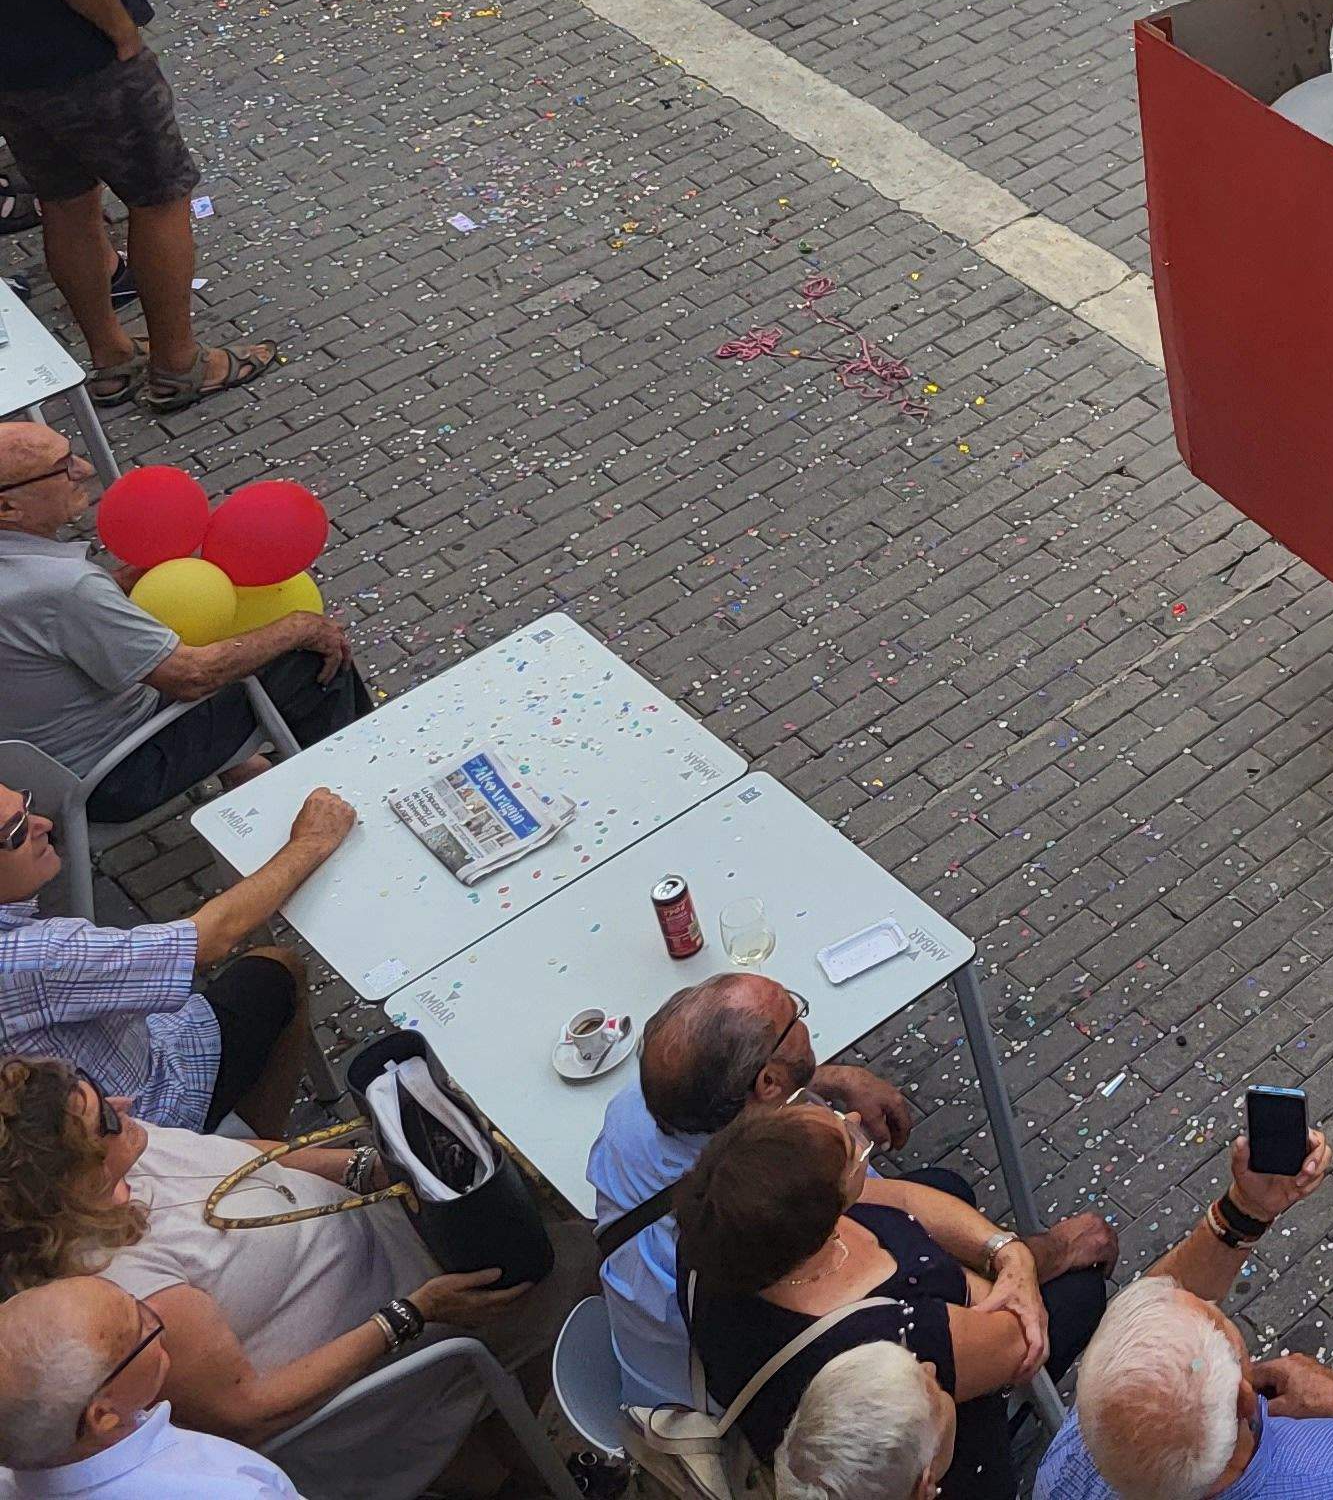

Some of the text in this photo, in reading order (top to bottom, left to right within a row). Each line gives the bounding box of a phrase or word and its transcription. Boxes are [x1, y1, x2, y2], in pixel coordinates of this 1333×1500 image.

[684, 751, 721, 781] AMBAR
[218, 807, 254, 838] AMBAR
[909, 927, 951, 962] AMBAR
[416, 989, 456, 1026] AMBAR
